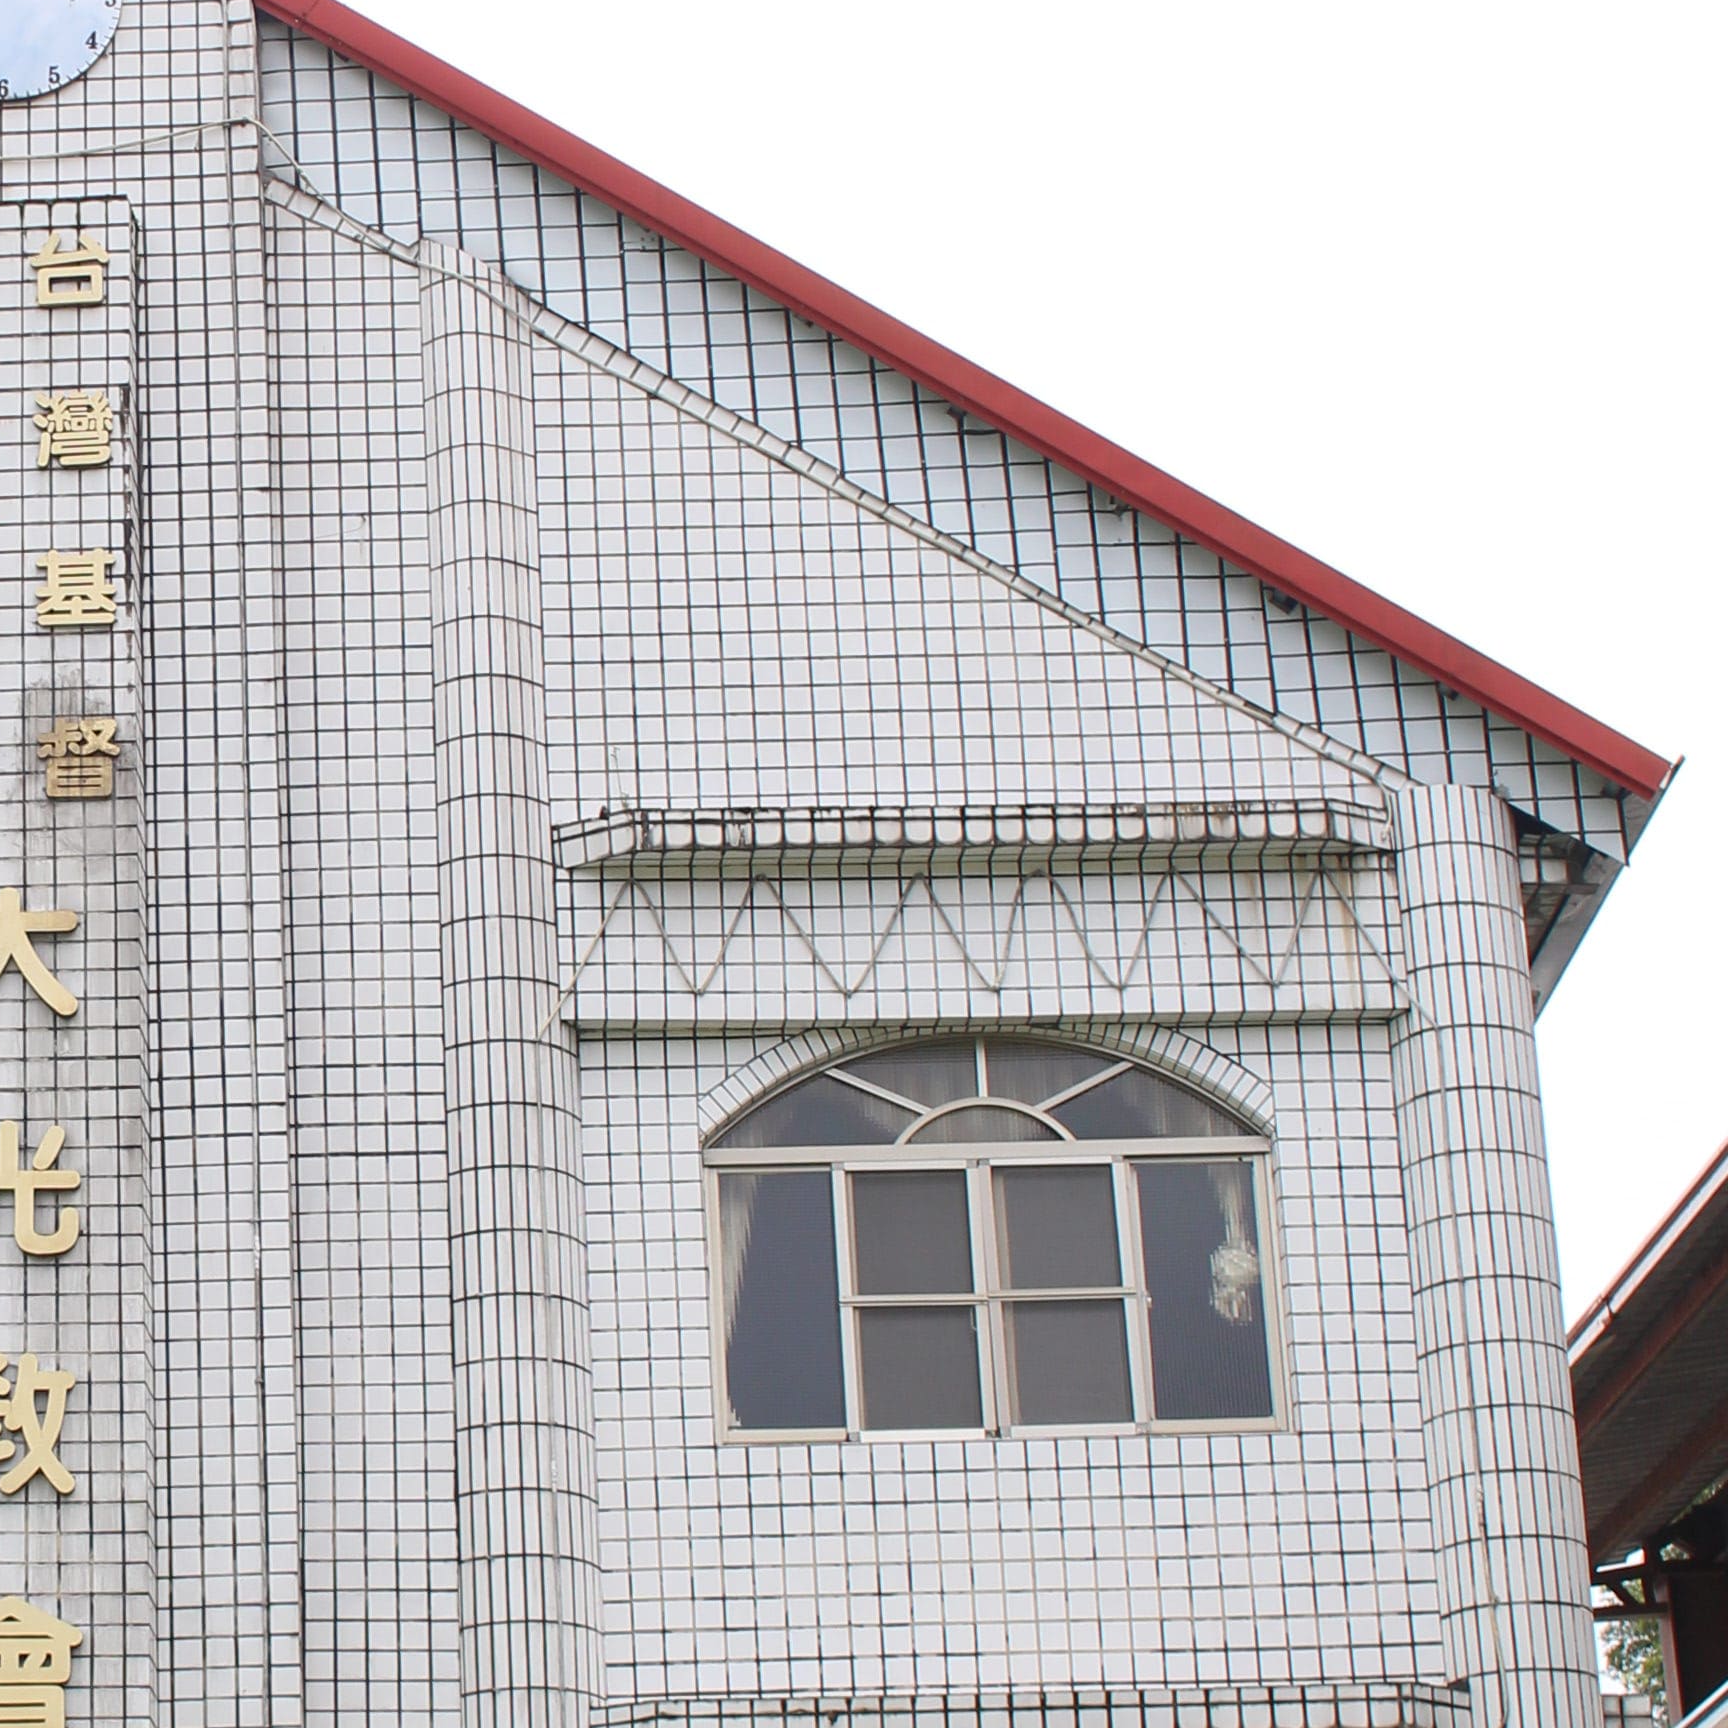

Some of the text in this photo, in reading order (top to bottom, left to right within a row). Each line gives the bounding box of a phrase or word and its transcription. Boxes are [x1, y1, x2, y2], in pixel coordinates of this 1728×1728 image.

[85, 31, 98, 50] 4
[48, 66, 61, 84] 5
[30, 233, 120, 799] 台灣基督
